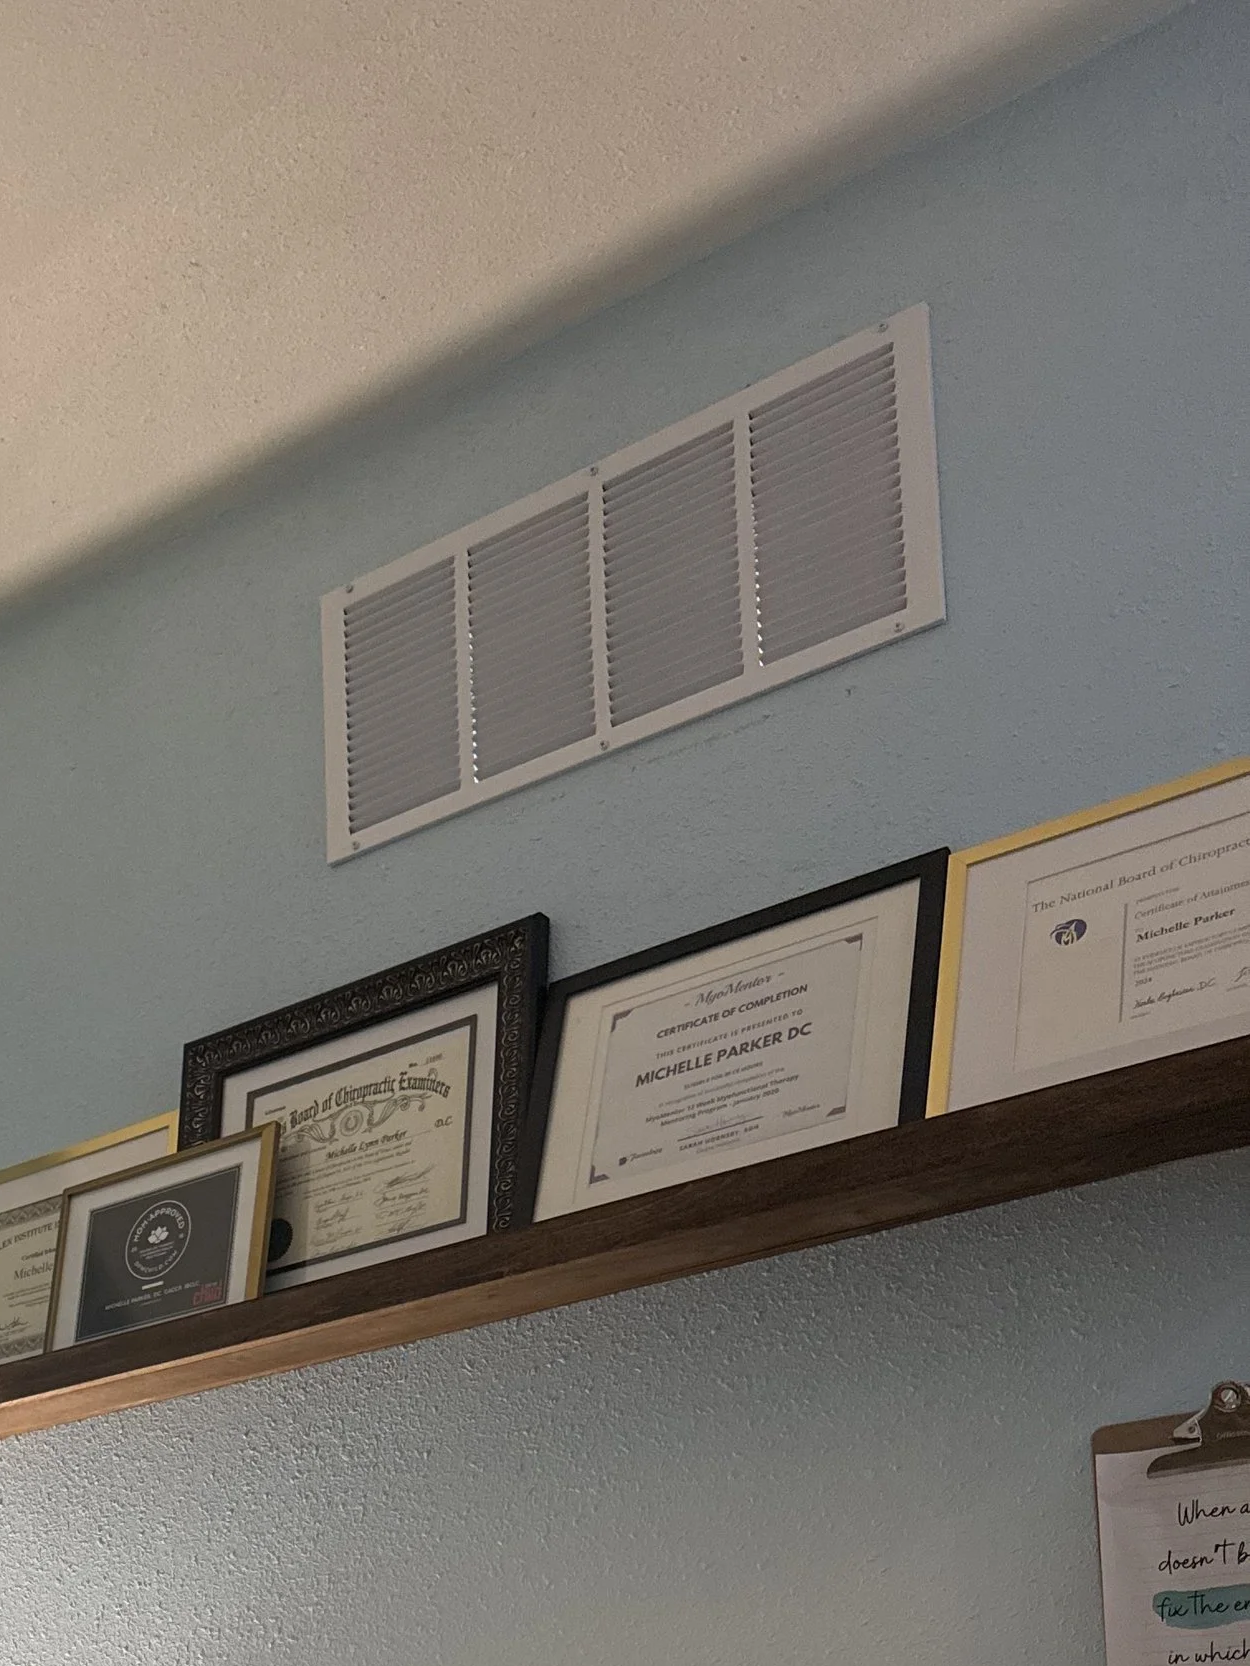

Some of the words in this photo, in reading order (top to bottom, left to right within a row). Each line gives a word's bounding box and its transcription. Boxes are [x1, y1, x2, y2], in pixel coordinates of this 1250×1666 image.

[1031, 901, 1056, 914] The
[1060, 879, 1114, 906] National
[1117, 865, 1157, 887] Board
[1159, 860, 1175, 873] of
[1134, 900, 1183, 920] Certificate
[1135, 920, 1191, 944] Michelle
[1193, 908, 1236, 927] Parker
[656, 1012, 721, 1040] CERTIFICATE
[721, 1006, 737, 1019] OF
[737, 983, 808, 1014] COMPLETION
[655, 1050, 675, 1060] THIS
[676, 1033, 728, 1054] CERTIFICATE
[730, 1028, 739, 1038] IS
[740, 1012, 790, 1034] PRESENTED
[791, 1008, 804, 1018] TO
[634, 1053, 713, 1088] MICHELLE
[715, 1031, 783, 1064] PARKER
[786, 1021, 813, 1042] DC
[290, 1099, 319, 1130] Board
[321, 1092, 334, 1113] of
[334, 1075, 397, 1107] Chiropractic
[398, 1071, 450, 1099] Examiners
[326, 1144, 357, 1160] Michelle
[380, 1129, 408, 1144] Parker
[14, 1222, 53, 1243] INSTITUTE
[1177, 1499, 1236, 1527] When
[1158, 1538, 1236, 1575] doesn't
[1157, 1596, 1190, 1622] fix
[1187, 1590, 1229, 1615] the
[1168, 1650, 1190, 1665] in
